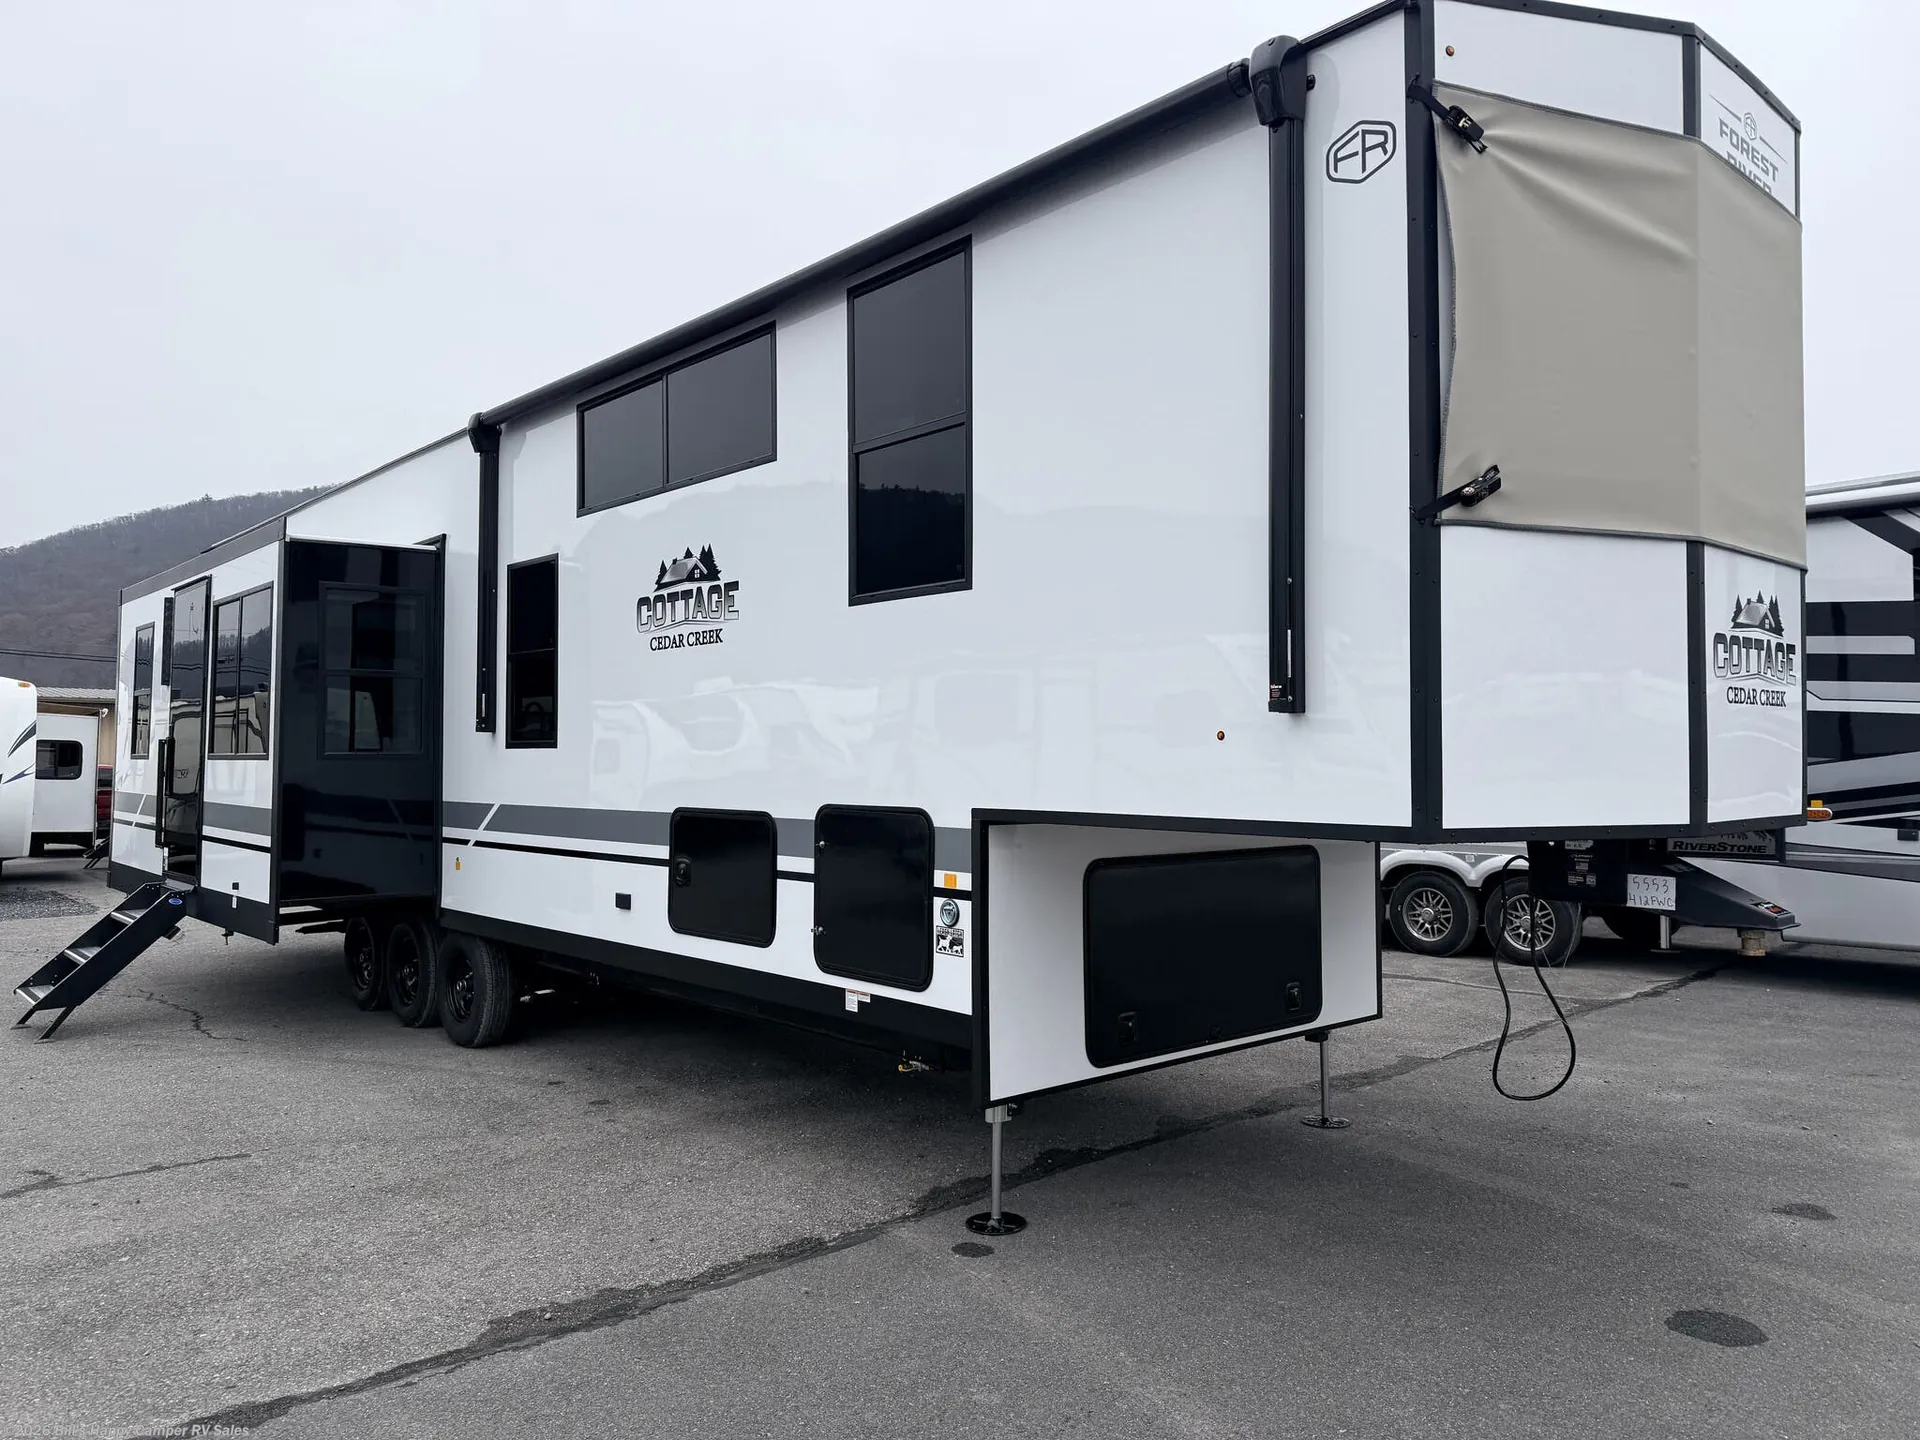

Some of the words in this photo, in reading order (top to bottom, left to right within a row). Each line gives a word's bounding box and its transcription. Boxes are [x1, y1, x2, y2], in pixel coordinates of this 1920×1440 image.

[1718, 116, 1779, 182] FOREST
[636, 580, 740, 634] COTTAGE
[649, 633, 686, 652] CEDAR
[686, 628, 724, 647] CREEK
[1713, 632, 1797, 686] COTTAGE
[1726, 686, 1758, 705] CEDAR
[1759, 689, 1787, 707] CREEK
[1632, 875, 1669, 894] 5553
[1628, 892, 1674, 908] 412FWC
